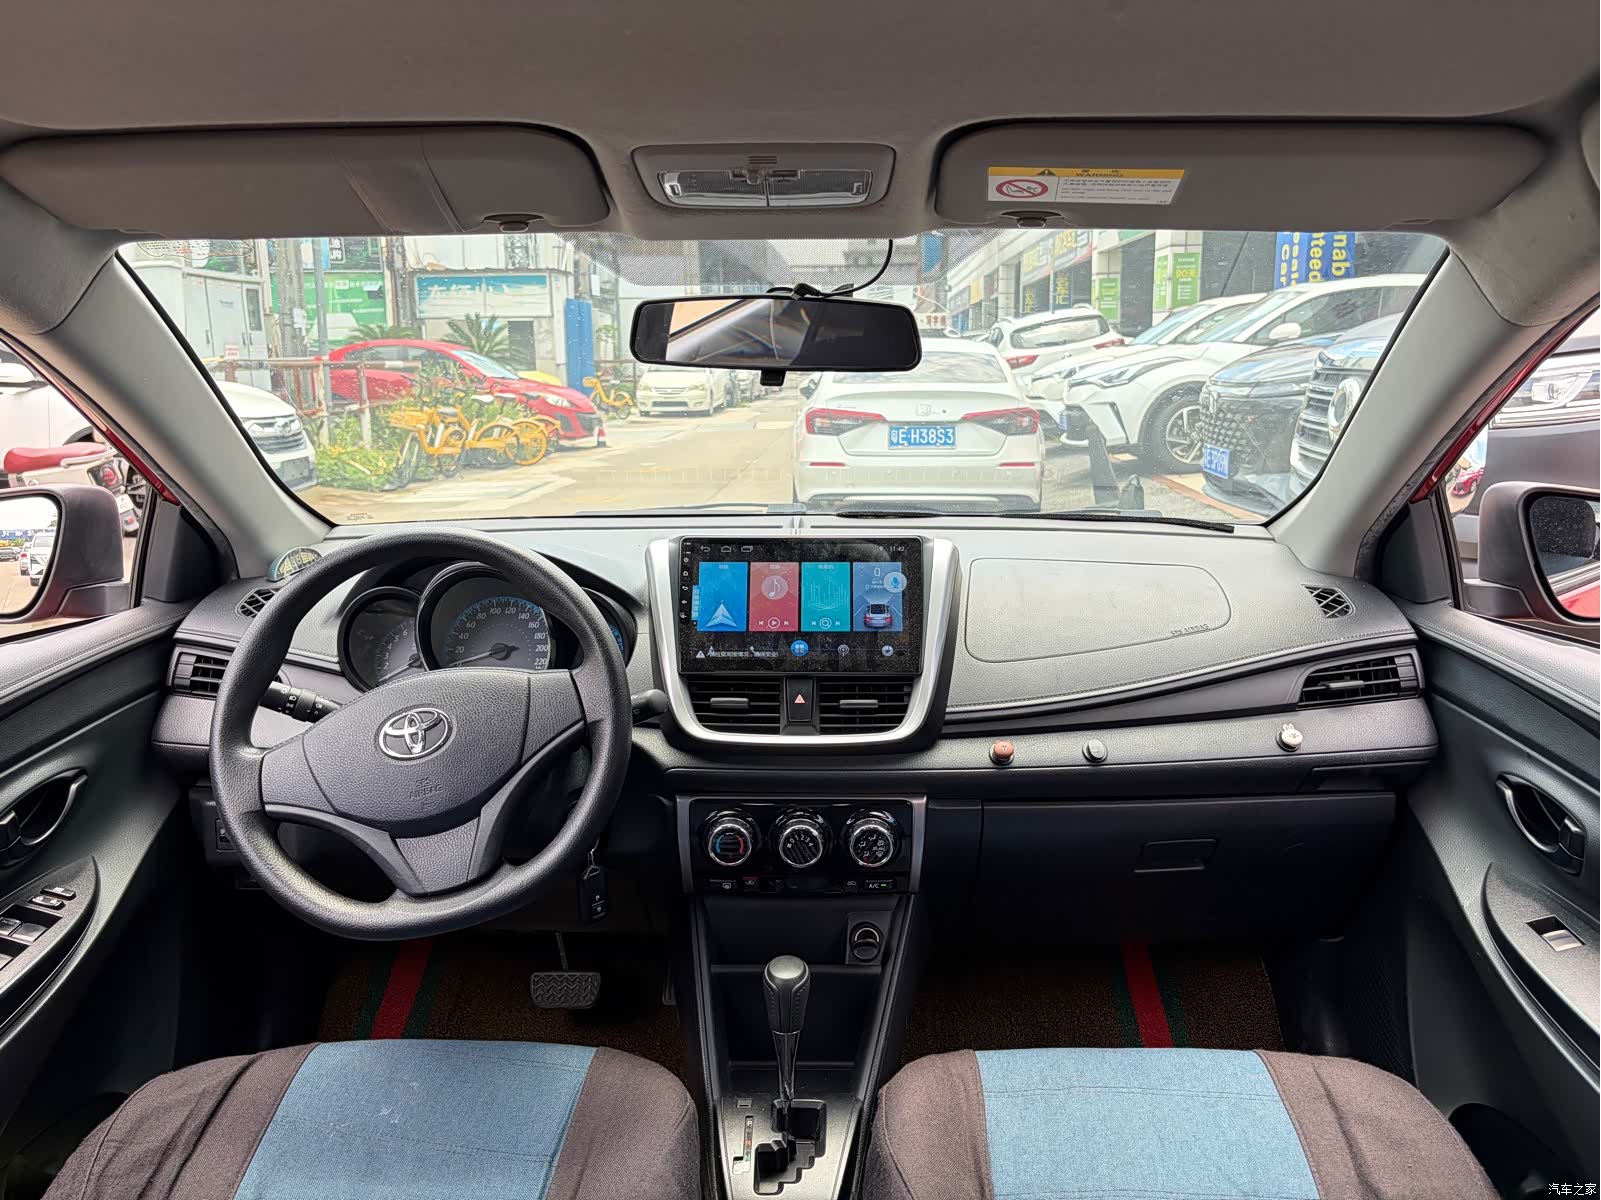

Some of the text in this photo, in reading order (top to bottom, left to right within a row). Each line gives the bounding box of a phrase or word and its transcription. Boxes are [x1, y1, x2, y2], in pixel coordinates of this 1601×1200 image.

[489, 607, 502, 615] 100
[504, 606, 516, 614] 120
[476, 612, 487, 620] 80
[518, 612, 530, 620] 140
[466, 621, 476, 629] 60
[528, 621, 540, 629] 160
[402, 628, 409, 637] 6
[458, 632, 469, 640] 40
[533, 632, 546, 640] 180
[394, 634, 400, 643] 5
[386, 642, 393, 650] 4
[454, 646, 465, 654] 20
[535, 644, 549, 652] 200
[383, 651, 389, 660] 3
[383, 661, 389, 670] 2
[533, 658, 547, 666] 220
